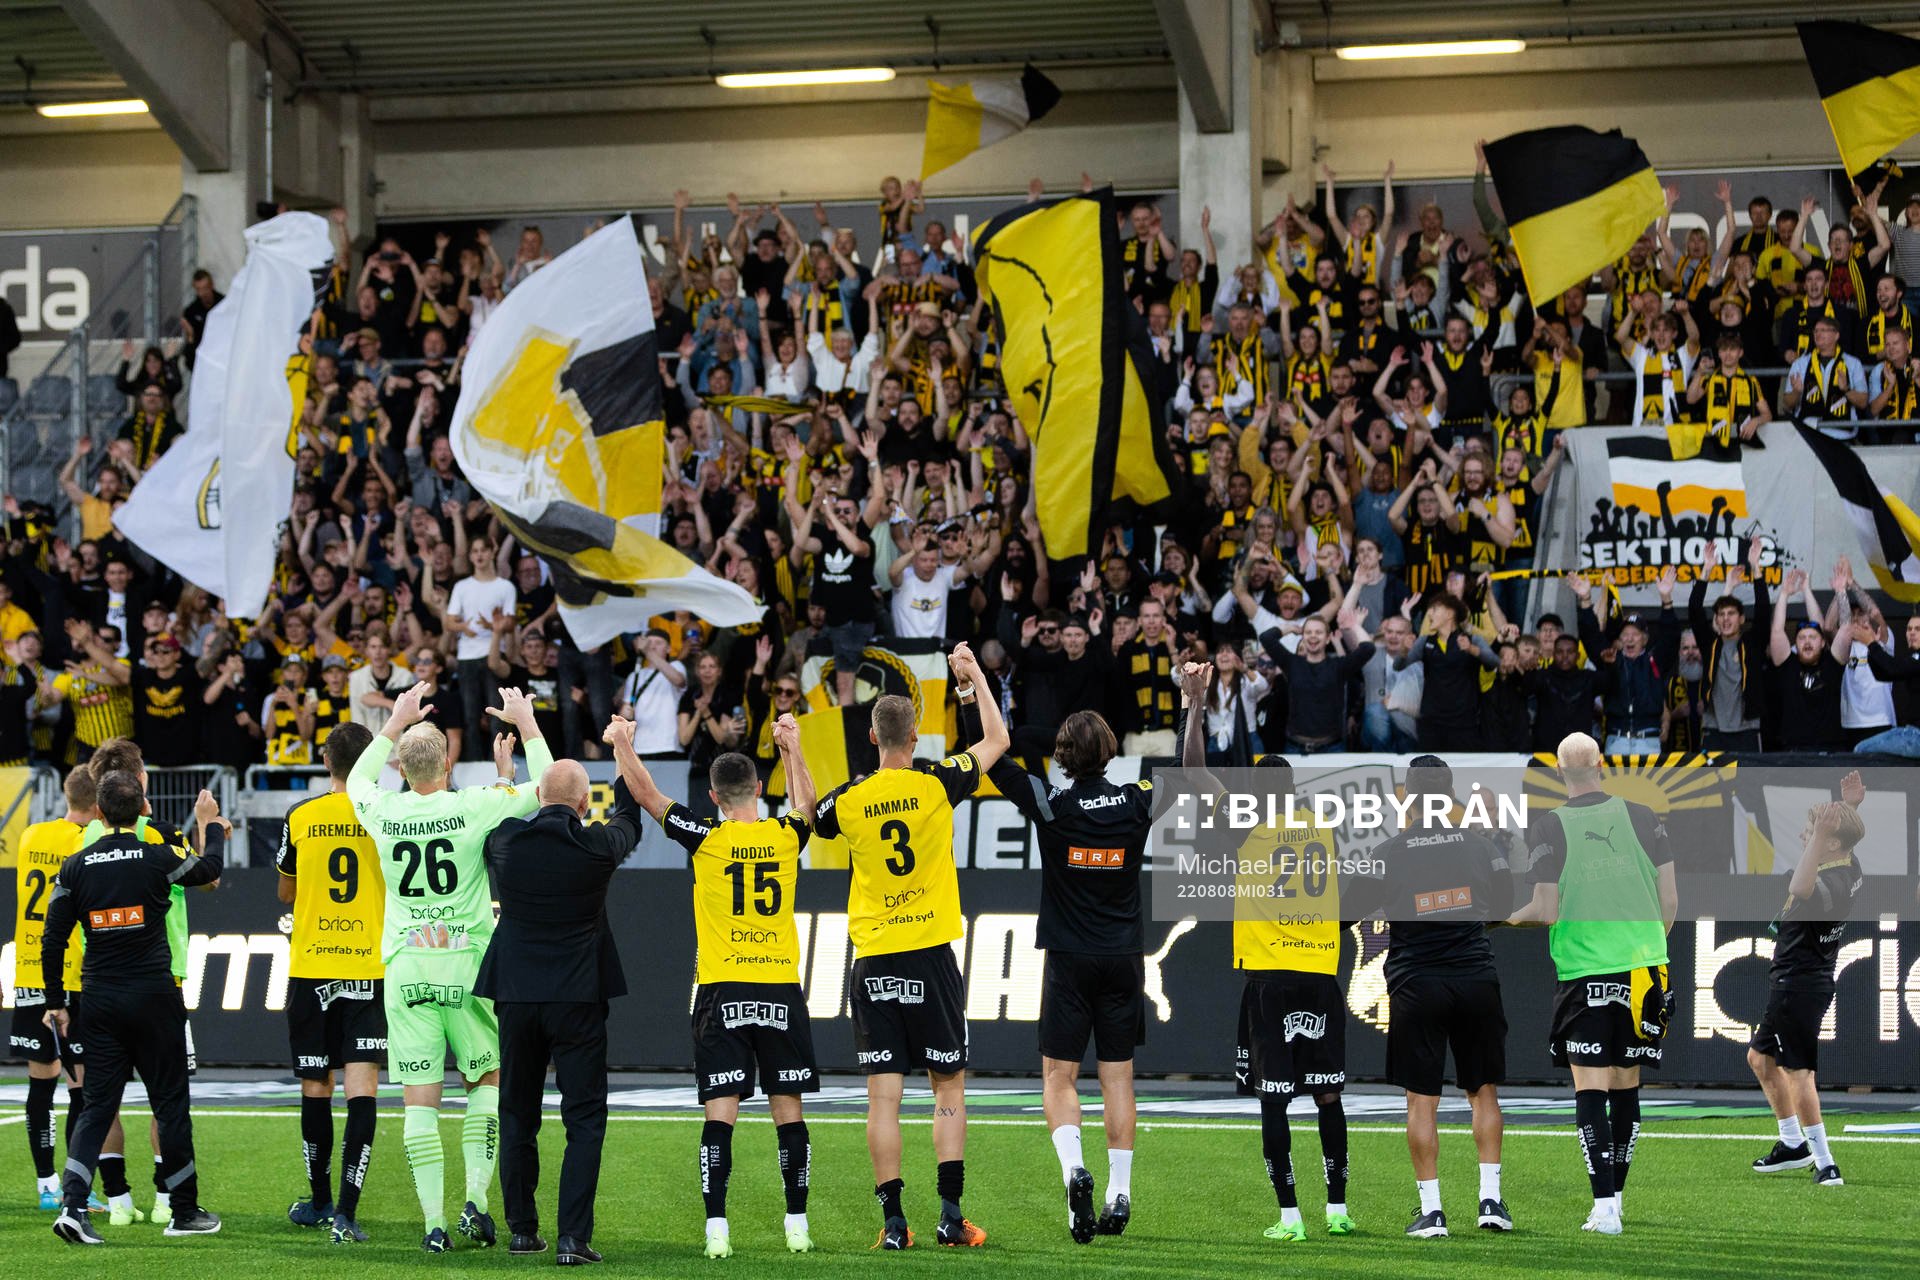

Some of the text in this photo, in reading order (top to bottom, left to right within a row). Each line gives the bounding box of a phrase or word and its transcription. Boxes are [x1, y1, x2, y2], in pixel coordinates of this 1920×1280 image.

[1581, 536, 1739, 568] SEKTION
[864, 797, 919, 818] HAMMAR
[1079, 792, 1126, 810] tadium
[381, 816, 467, 836] ABRAHAMSSON
[668, 813, 711, 836] stadium
[880, 820, 916, 877] 3
[1406, 832, 1464, 848] stadium
[84, 848, 144, 866] stadium
[731, 846, 775, 860] HODZIC
[1073, 852, 1121, 862] BRA
[328, 847, 358, 903] 9
[392, 838, 458, 897] 26
[1269, 842, 1328, 898] 20
[724, 861, 782, 917] 15
[1420, 892, 1467, 907] BRA
[93, 911, 140, 924] BRA
[409, 905, 455, 920] brion
[917, 910, 935, 923] syd
[1278, 911, 1323, 926] brion
[318, 916, 363, 932] brion
[731, 928, 777, 943] brion
[315, 945, 372, 956] prefab syd
[1318, 940, 1335, 950] syd
[736, 953, 773, 965] prefab
[1694, 913, 1920, 1044] bri
[710, 1145, 720, 1167] TYRES
[700, 1145, 711, 1194] MAXXIS
